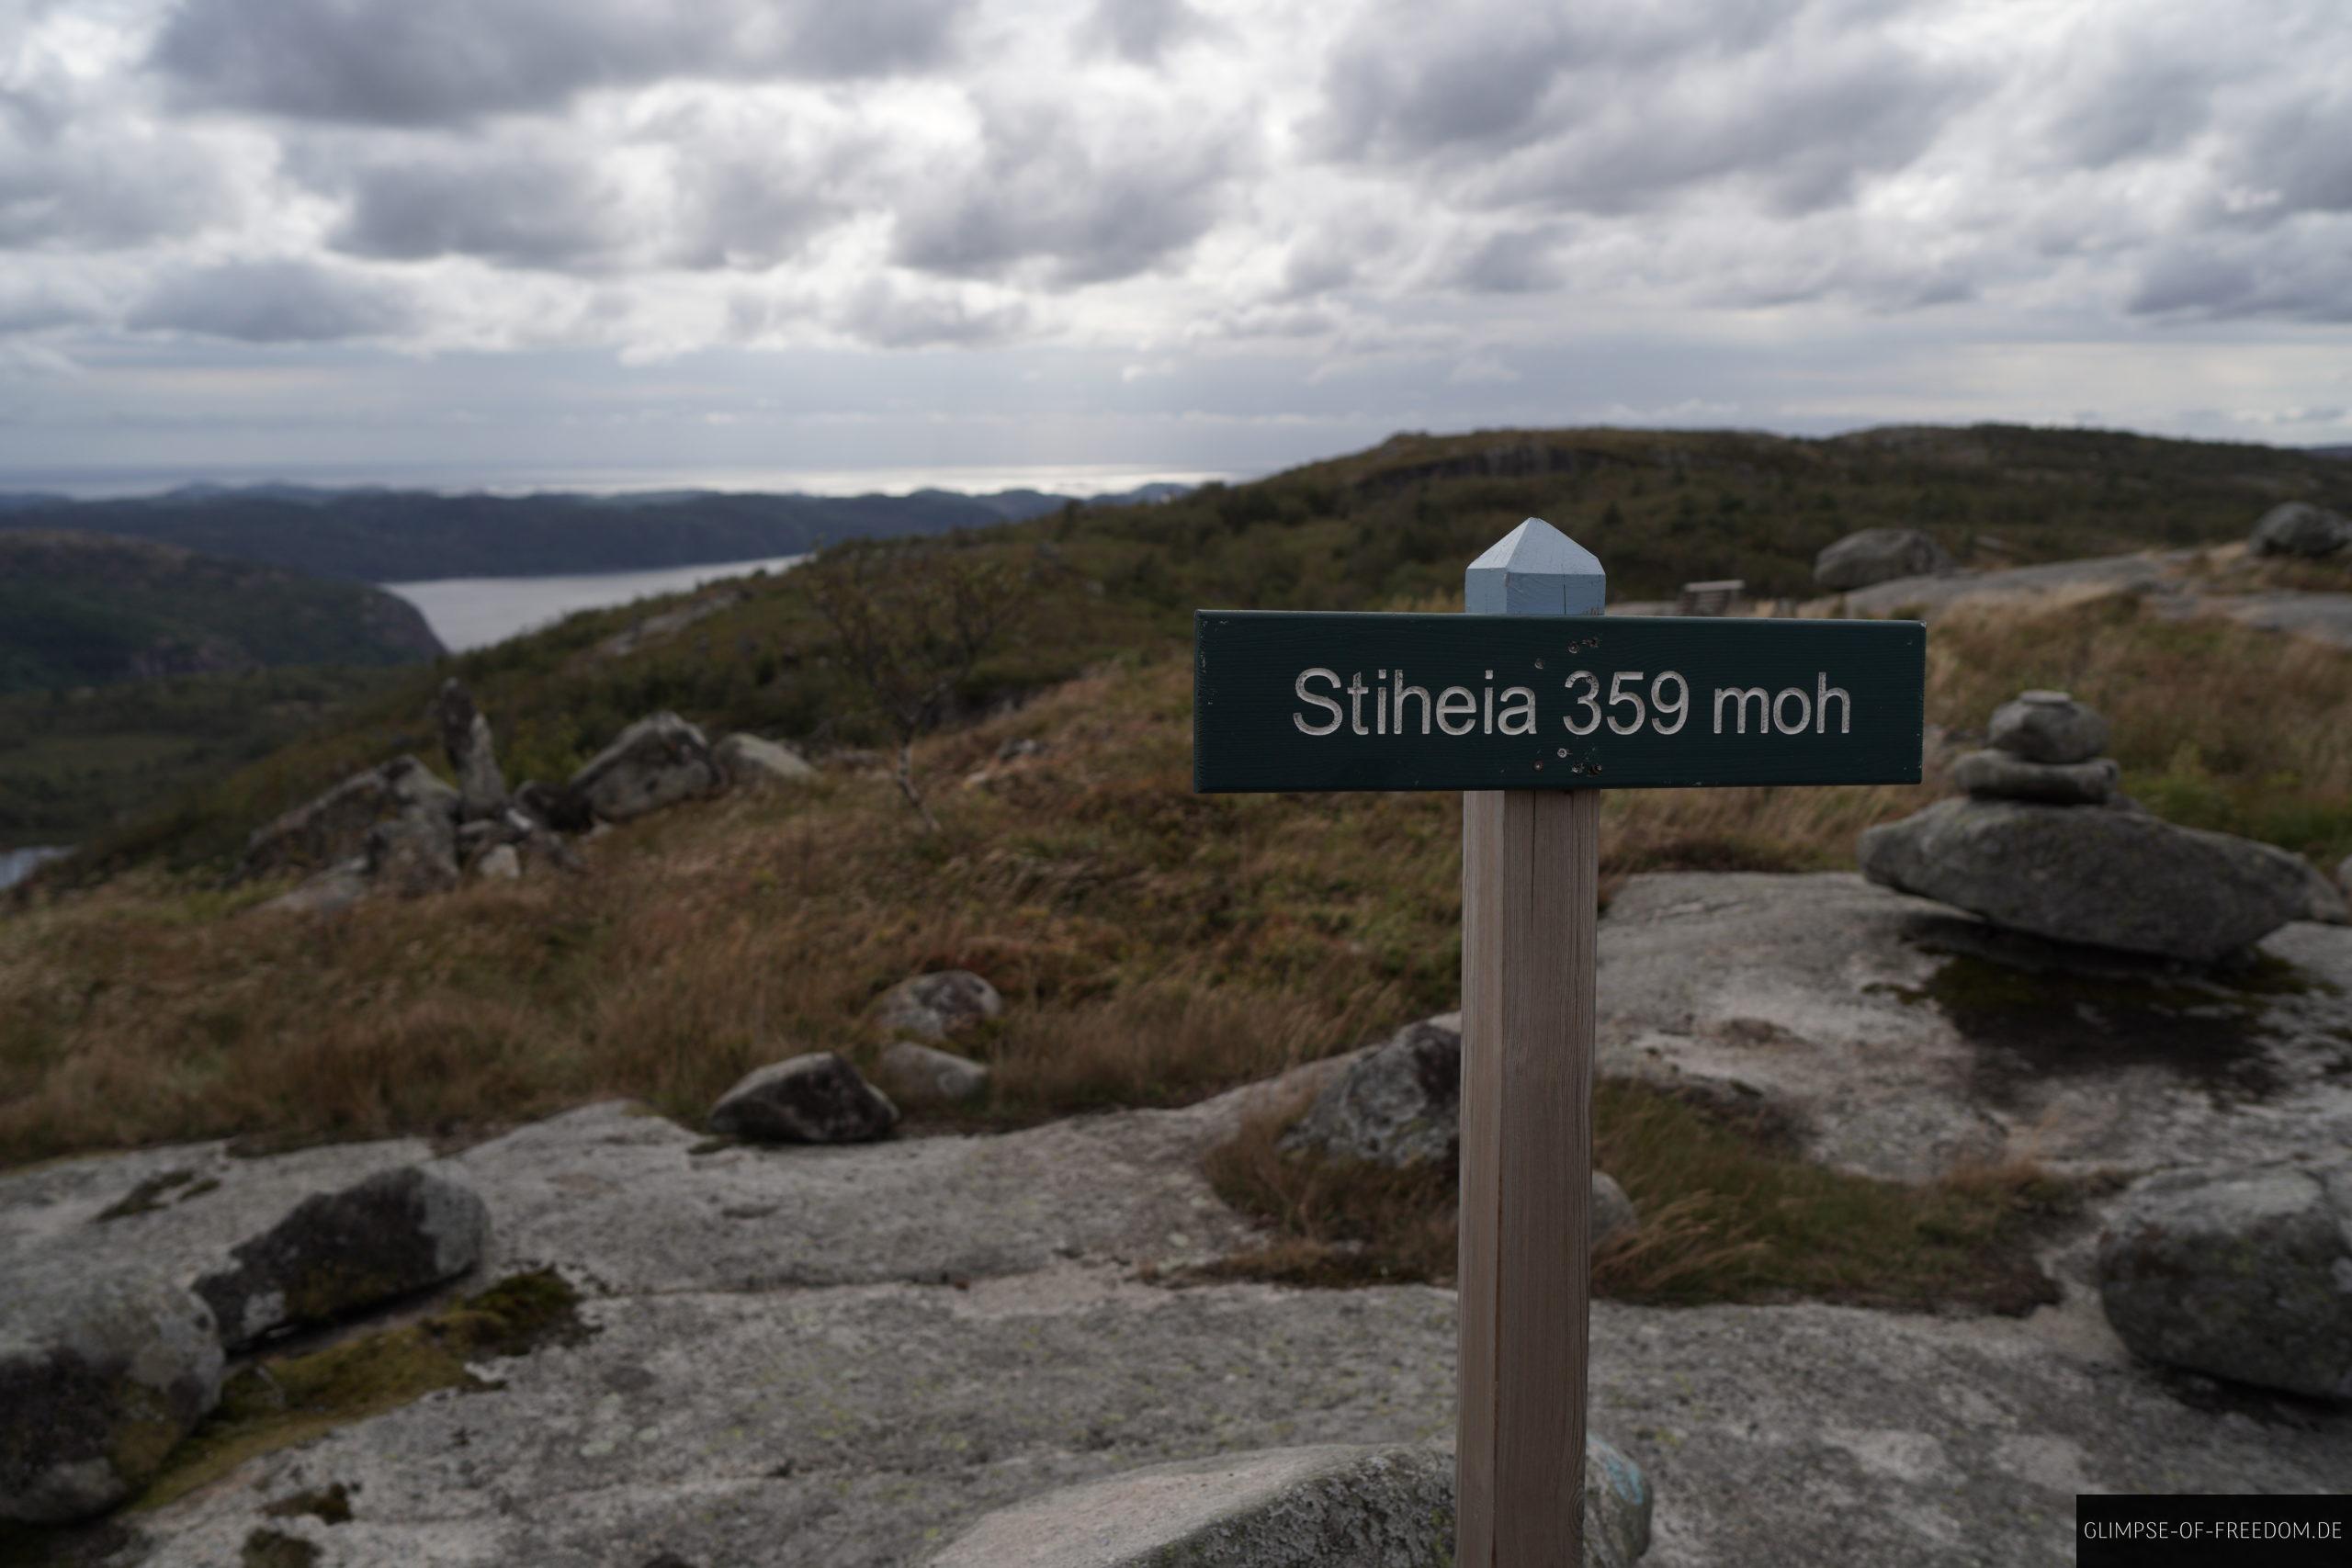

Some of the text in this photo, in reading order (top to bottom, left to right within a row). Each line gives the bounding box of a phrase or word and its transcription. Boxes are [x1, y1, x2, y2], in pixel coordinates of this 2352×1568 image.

[1293, 668, 1850, 737] Stiheia 359 moh
